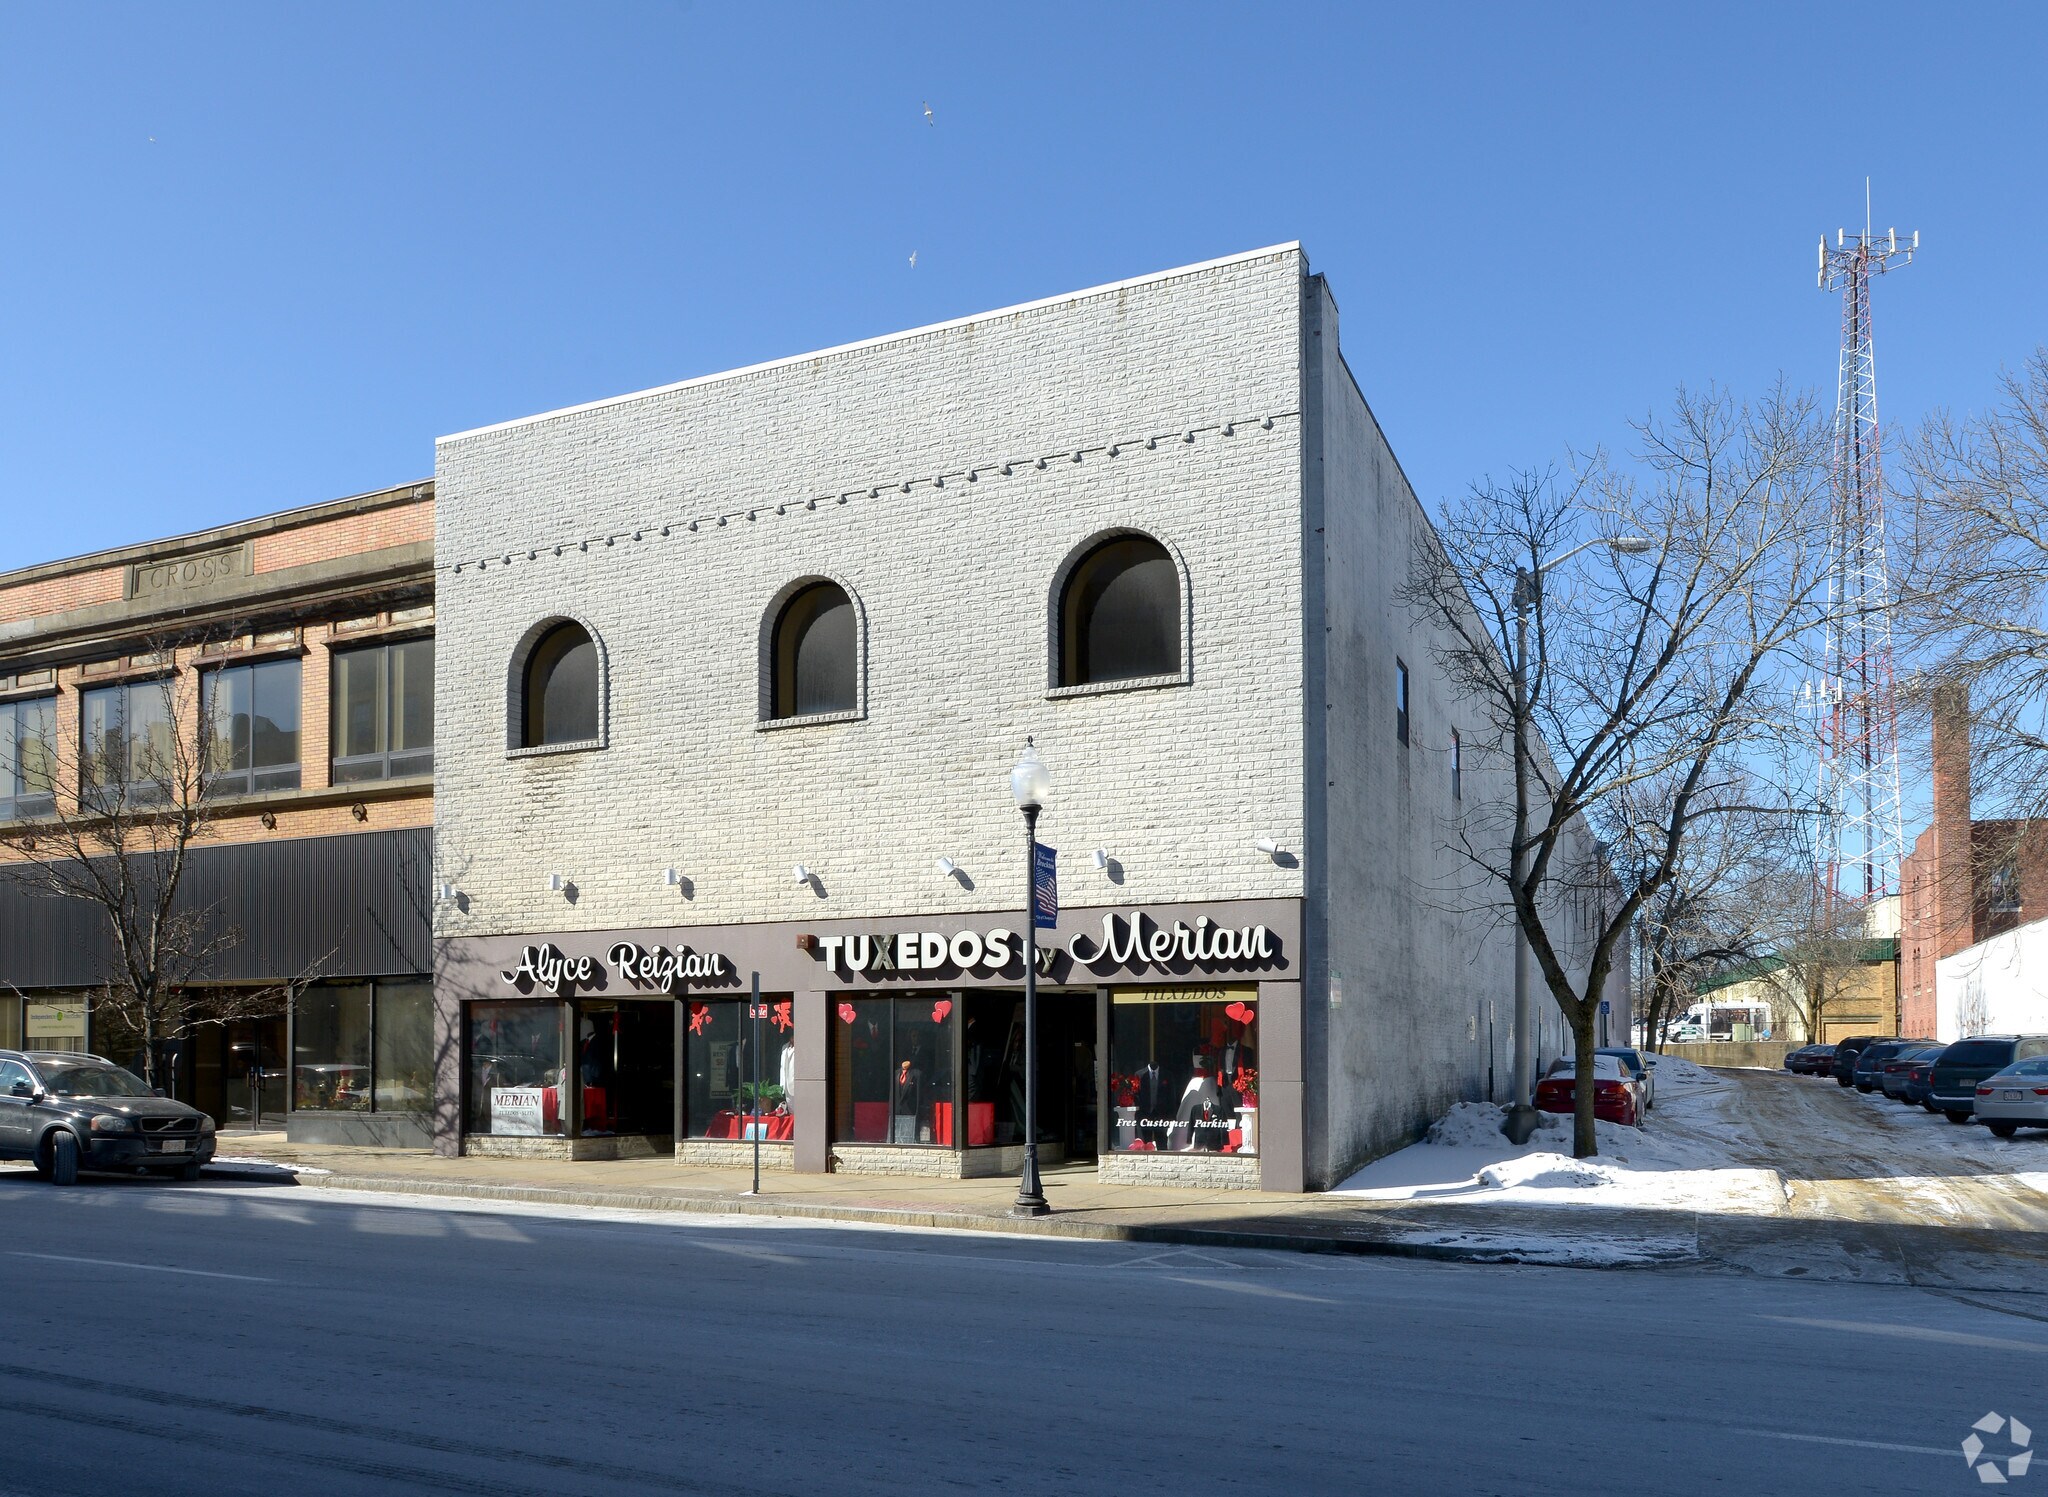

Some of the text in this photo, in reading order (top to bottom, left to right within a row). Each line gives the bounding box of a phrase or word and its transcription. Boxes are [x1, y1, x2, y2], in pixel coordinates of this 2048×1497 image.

[151, 554, 231, 588] CROSS
[819, 928, 1011, 972] TUXEDOS
[1069, 911, 1272, 964] Merian
[500, 941, 725, 994] Alyce Reizian
[1142, 986, 1227, 1001] TUXEDOS
[494, 1094, 539, 1107] MERIAN
[1115, 1118, 1137, 1127] Free
[1140, 1118, 1189, 1128] Customer
